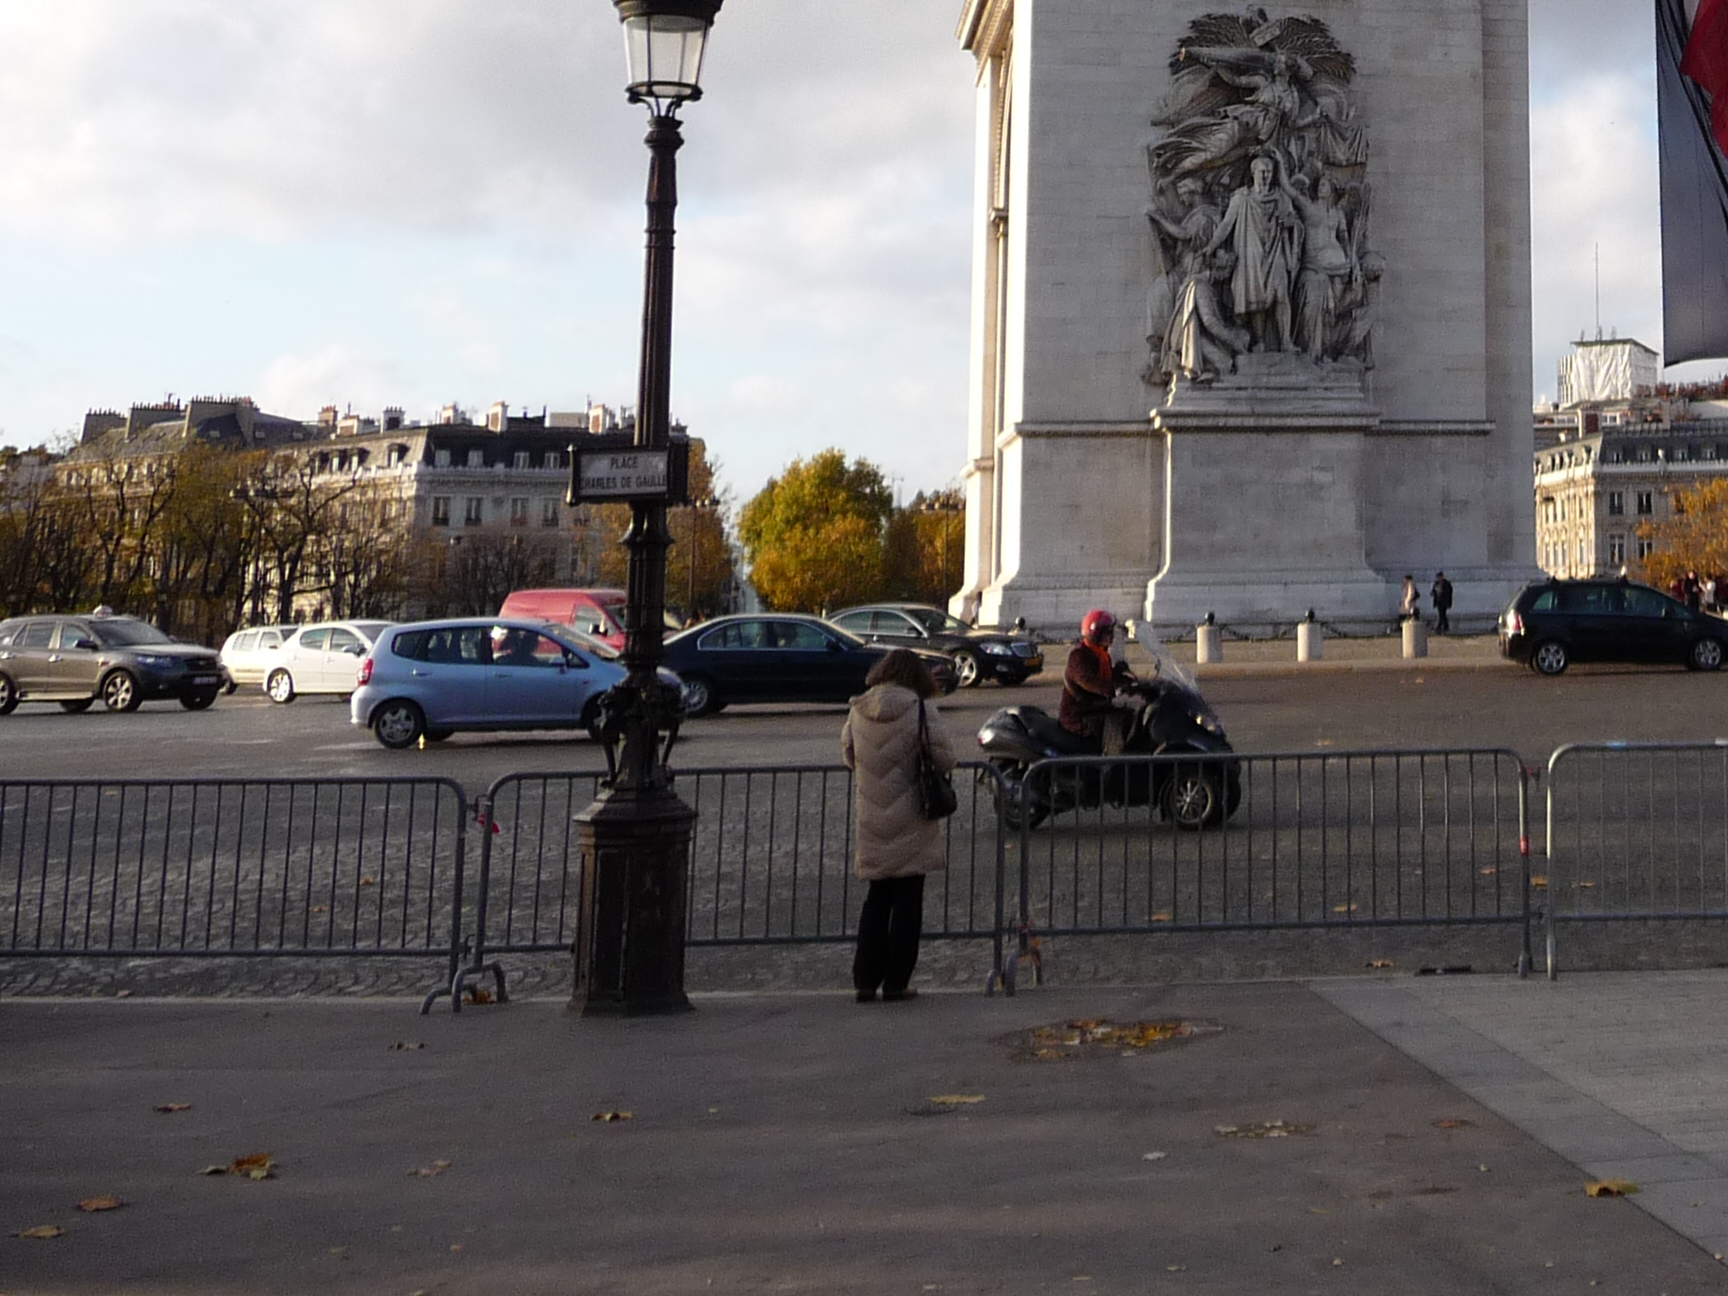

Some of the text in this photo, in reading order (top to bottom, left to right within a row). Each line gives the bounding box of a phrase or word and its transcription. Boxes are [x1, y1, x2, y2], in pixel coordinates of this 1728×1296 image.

[610, 456, 639, 470] PLACE
[580, 474, 667, 490] CHARLES DE GAULLE
